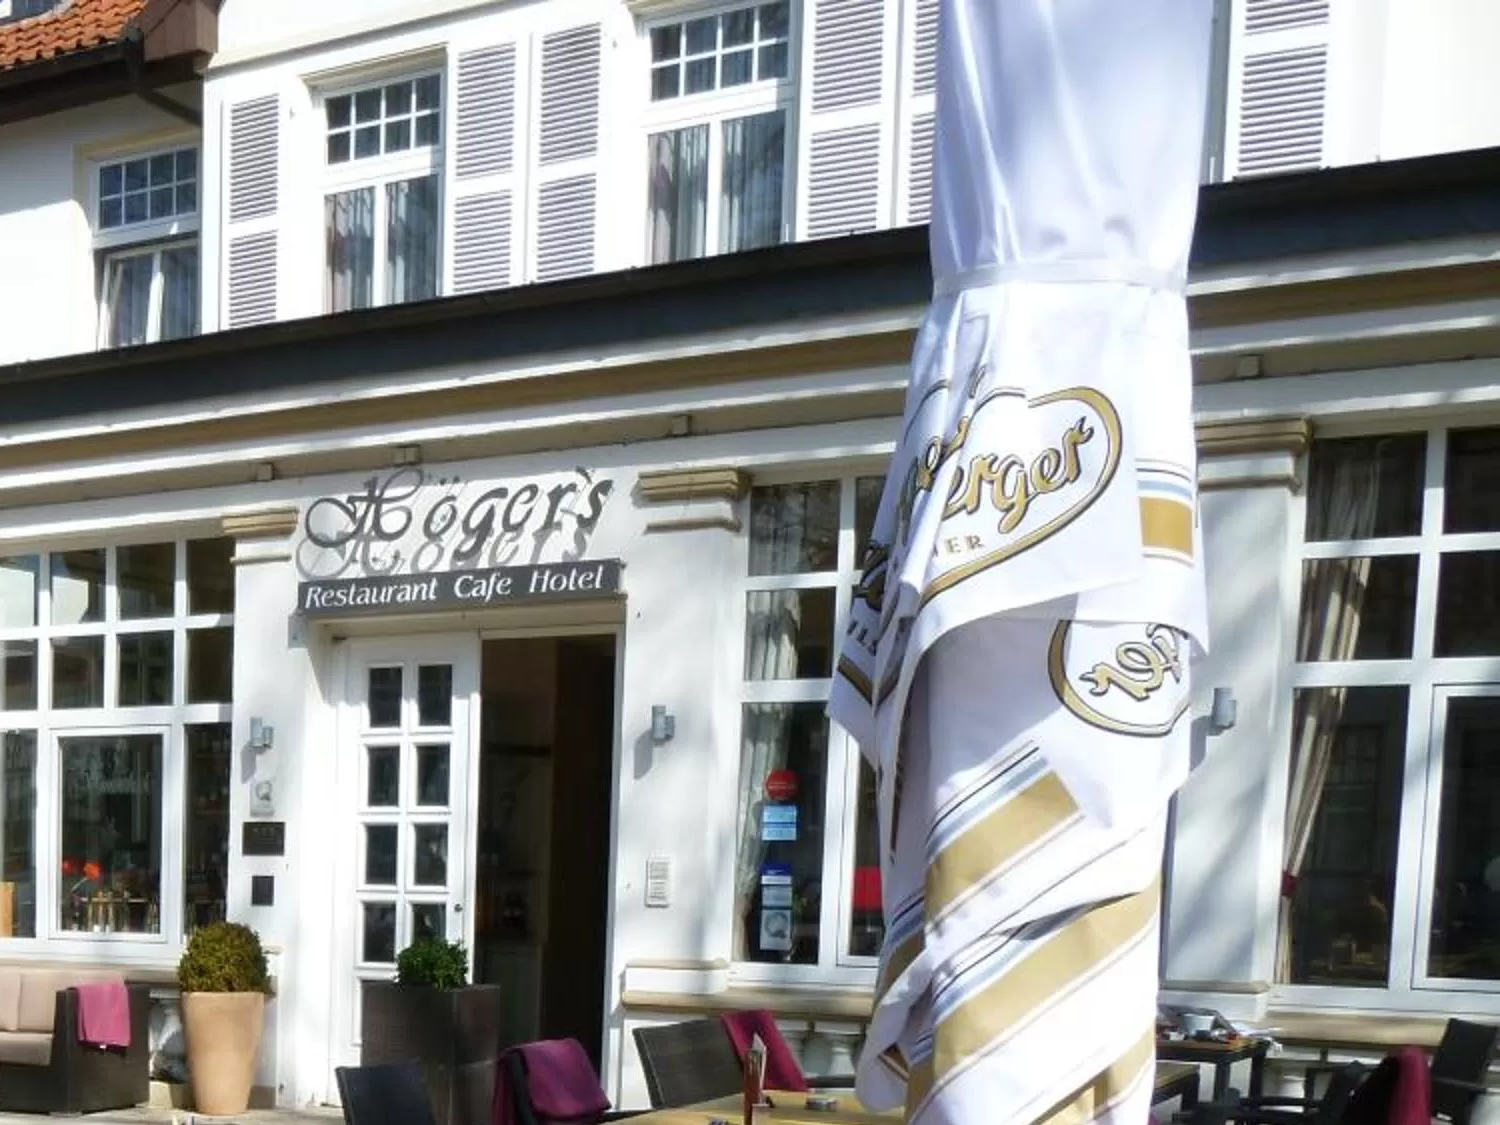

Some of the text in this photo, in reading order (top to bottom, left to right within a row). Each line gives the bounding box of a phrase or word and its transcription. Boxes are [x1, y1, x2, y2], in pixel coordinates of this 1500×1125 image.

[304, 563, 605, 609] Restaurant Cafe Hotel
